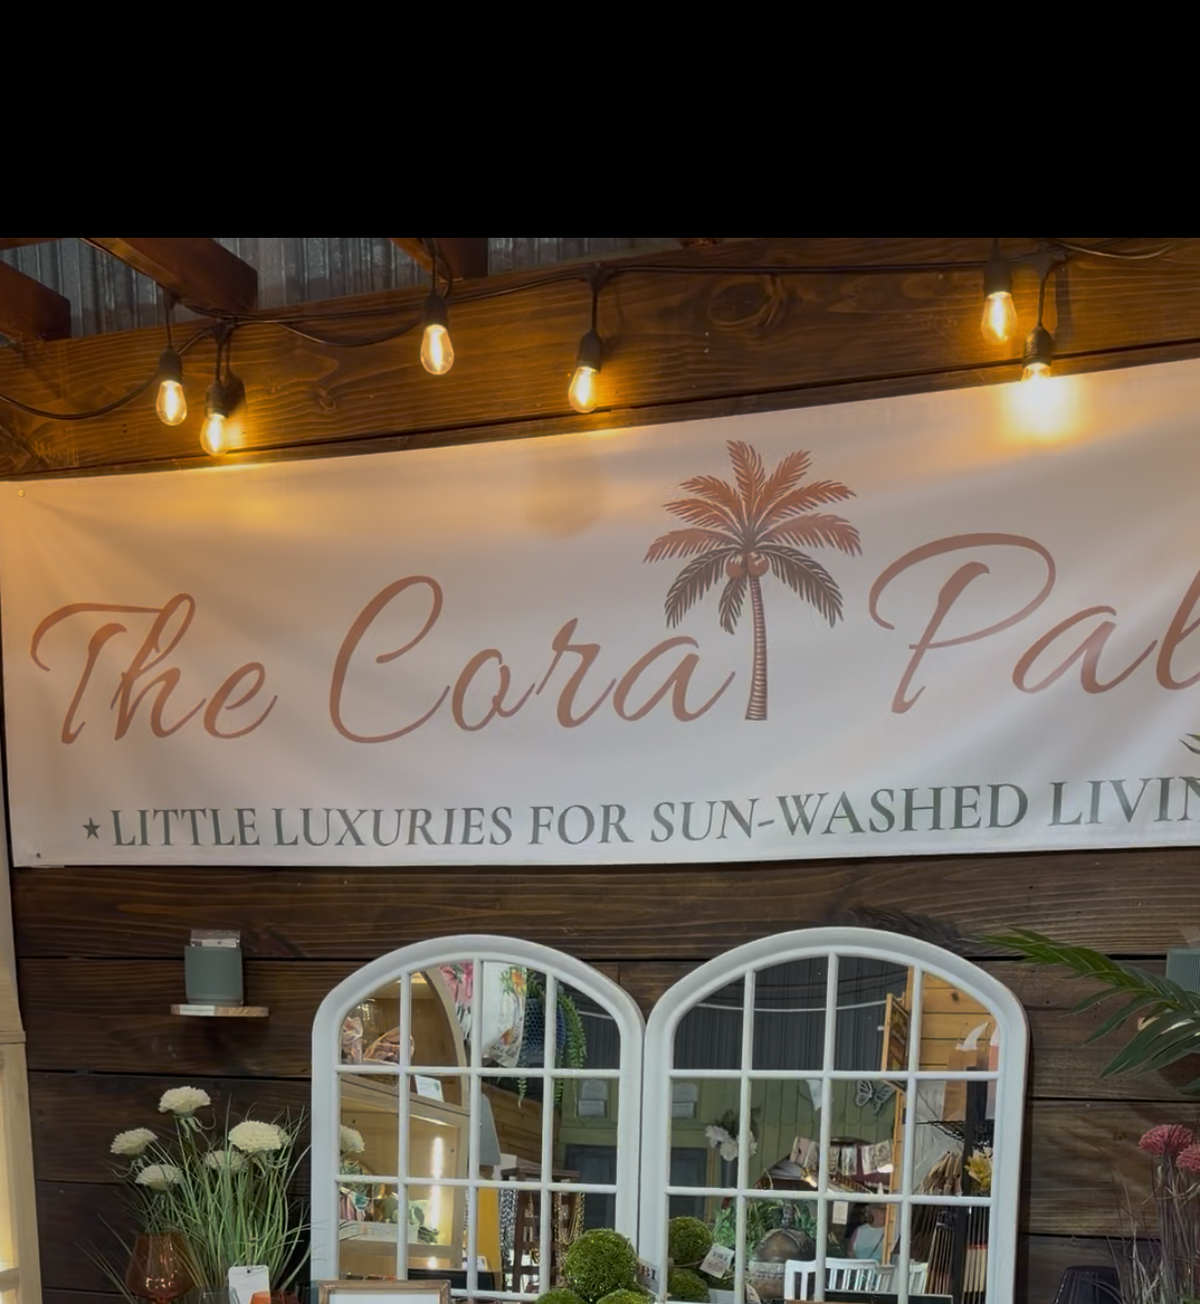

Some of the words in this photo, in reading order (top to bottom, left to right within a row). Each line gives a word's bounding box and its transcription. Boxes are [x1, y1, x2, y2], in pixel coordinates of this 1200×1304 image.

[30, 592, 279, 745] The
[111, 807, 260, 847] LITTLE
[273, 805, 513, 847] LUXURIES
[529, 803, 632, 846] FOR
[650, 782, 1028, 844] SUN-WASHED
